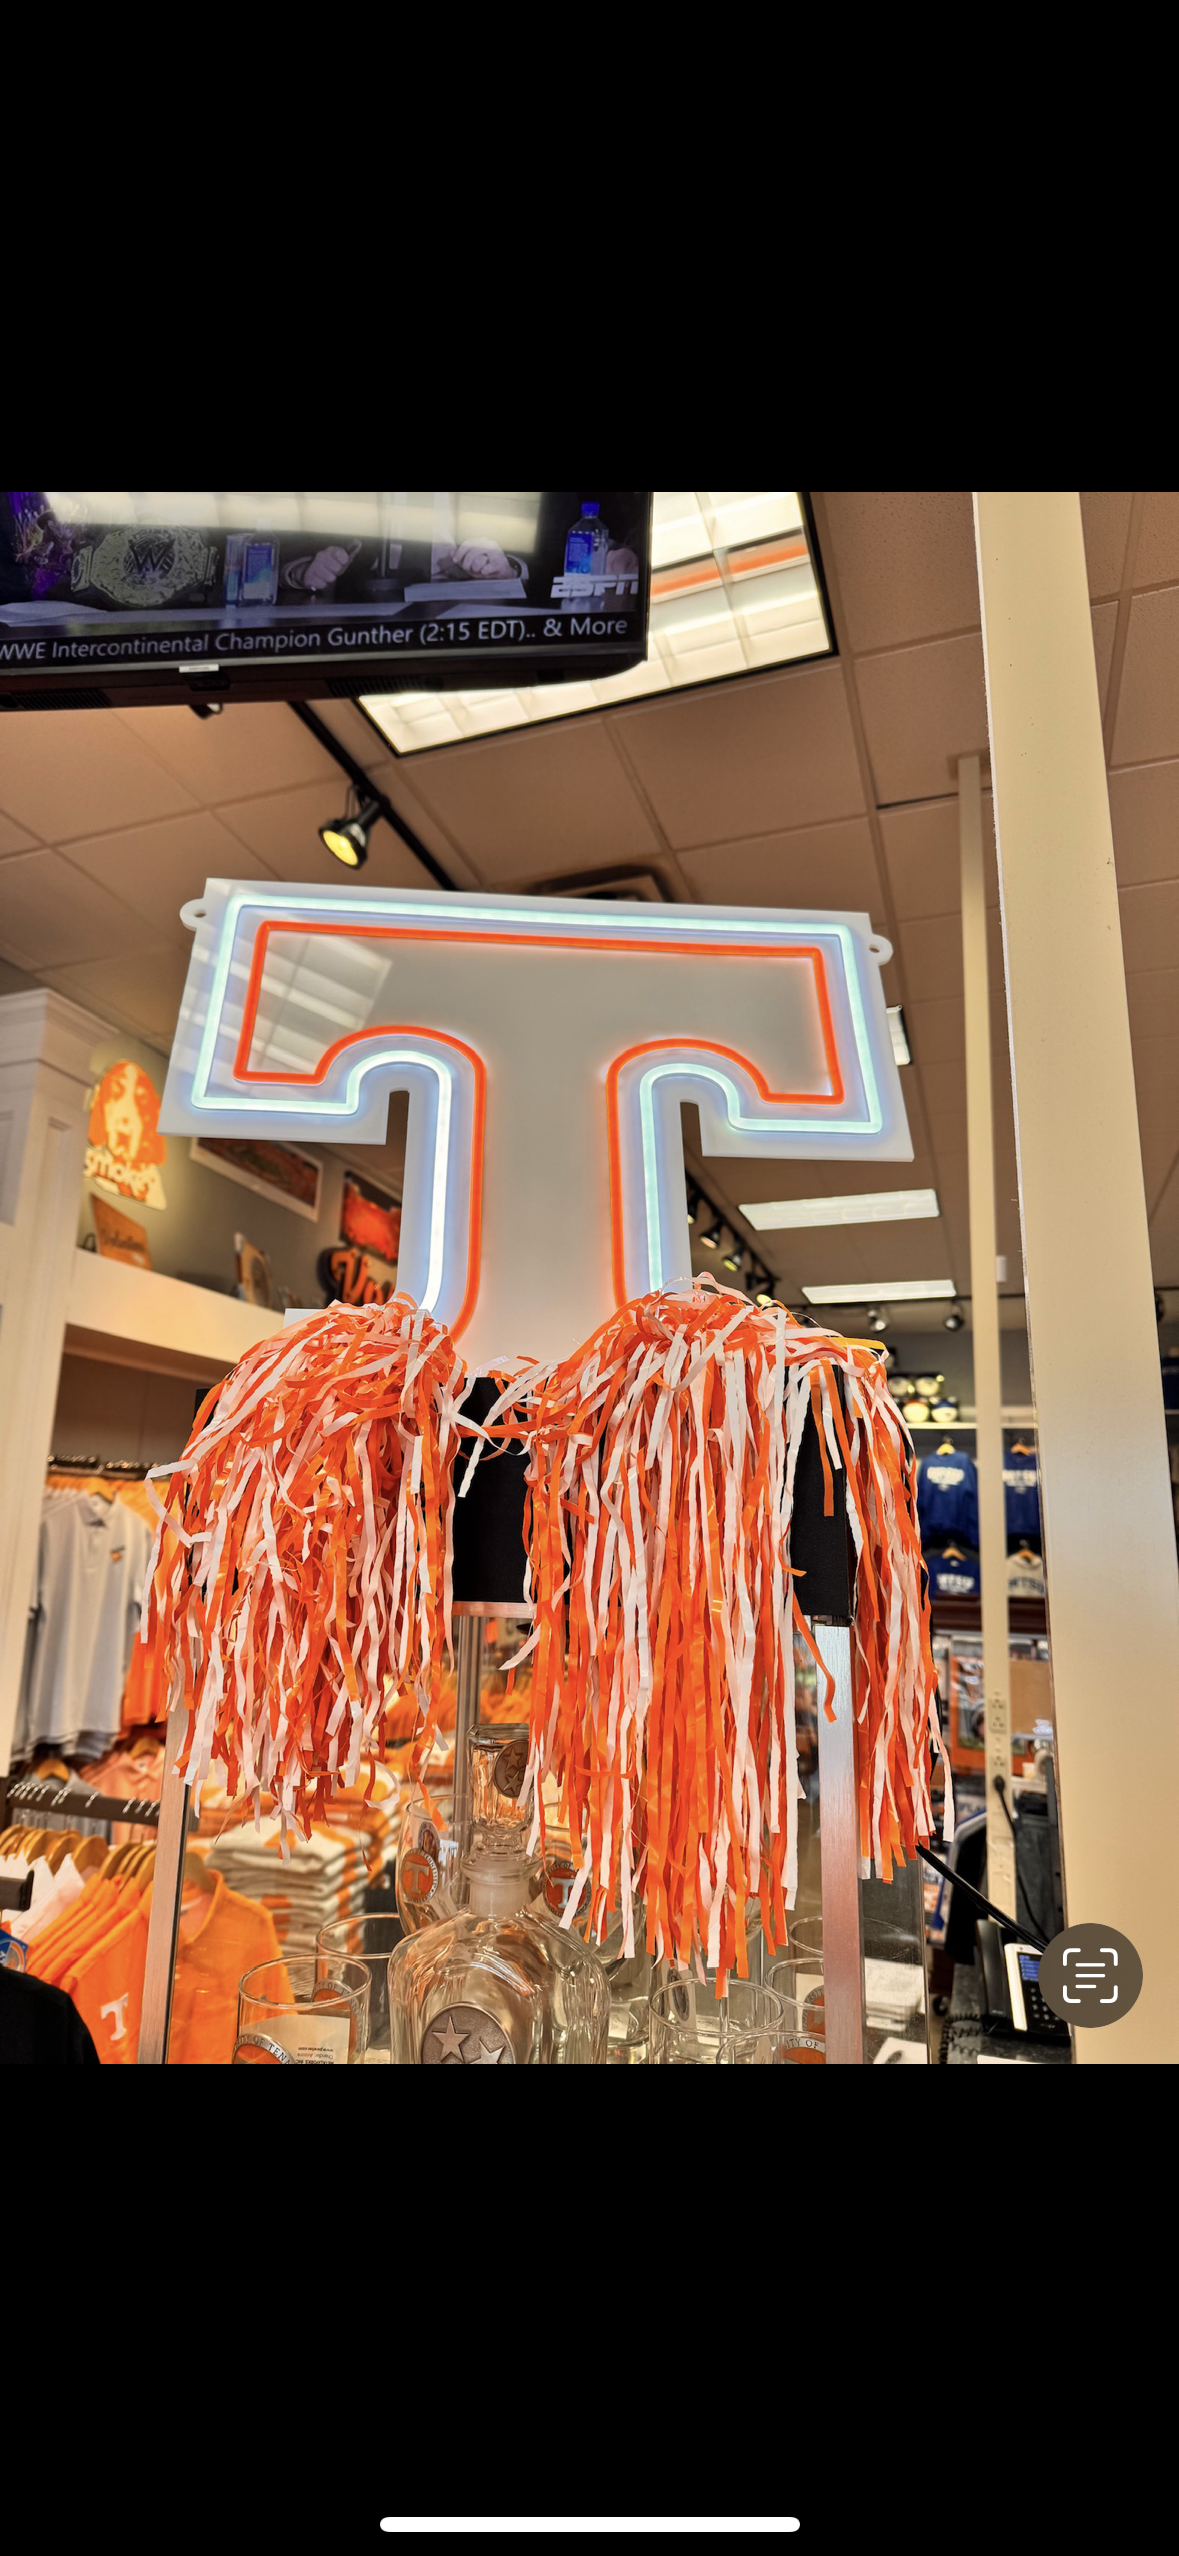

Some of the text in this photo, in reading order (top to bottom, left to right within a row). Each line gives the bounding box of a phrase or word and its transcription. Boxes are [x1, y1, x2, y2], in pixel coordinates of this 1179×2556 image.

[550, 573, 639, 599] ESPN
[0, 616, 628, 661] WWE Intercontinental Champion Gunther (2:15 EDT).. & More
[190, 892, 884, 1345] T
[100, 1992, 129, 2041] T
[805, 2039, 819, 2049] OF
